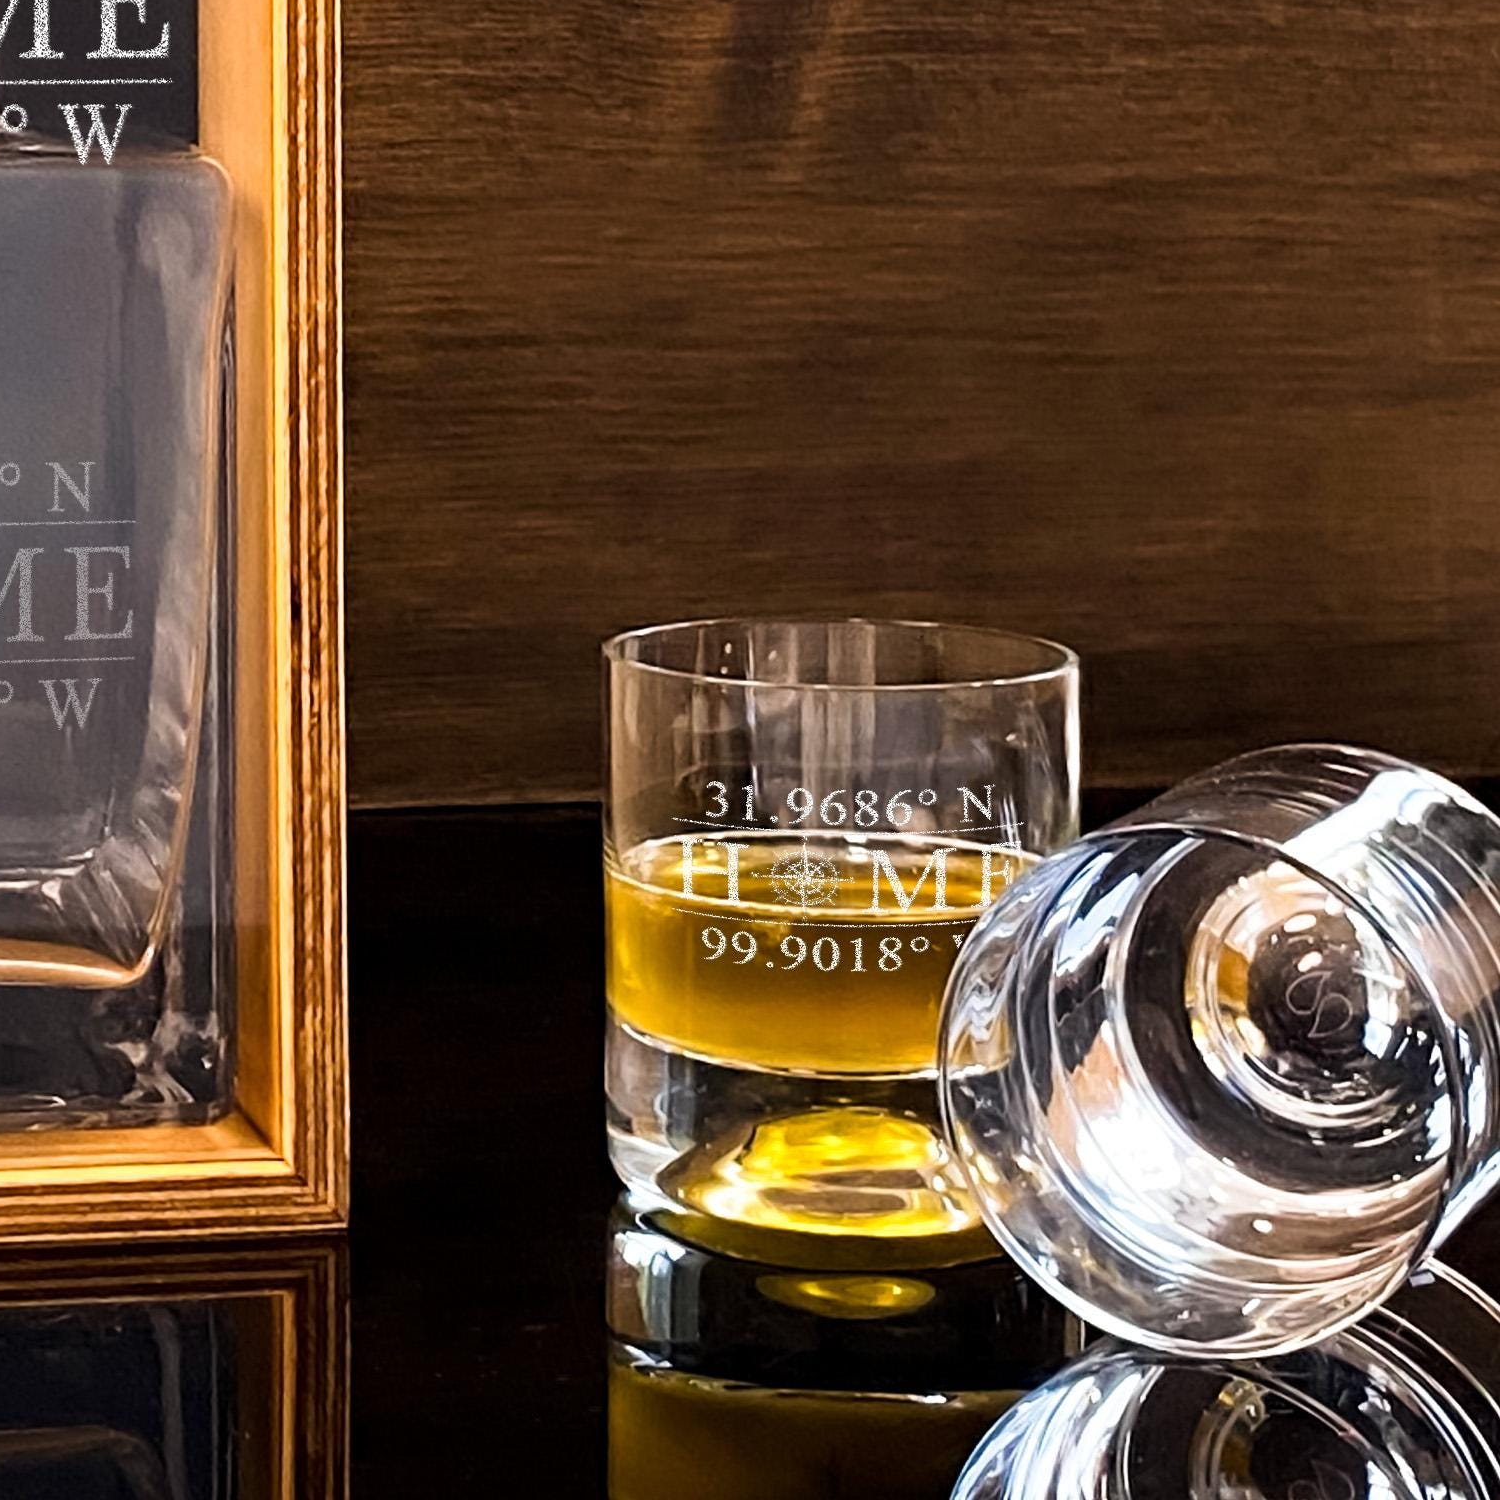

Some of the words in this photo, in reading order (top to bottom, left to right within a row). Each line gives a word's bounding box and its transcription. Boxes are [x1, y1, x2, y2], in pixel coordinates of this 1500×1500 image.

[56, 103, 133, 166] W
[44, 461, 96, 514] N
[38, 676, 104, 731] W
[704, 780, 938, 827] 31.9686°
[956, 782, 997, 824] N
[701, 926, 931, 973] 99.9018°
